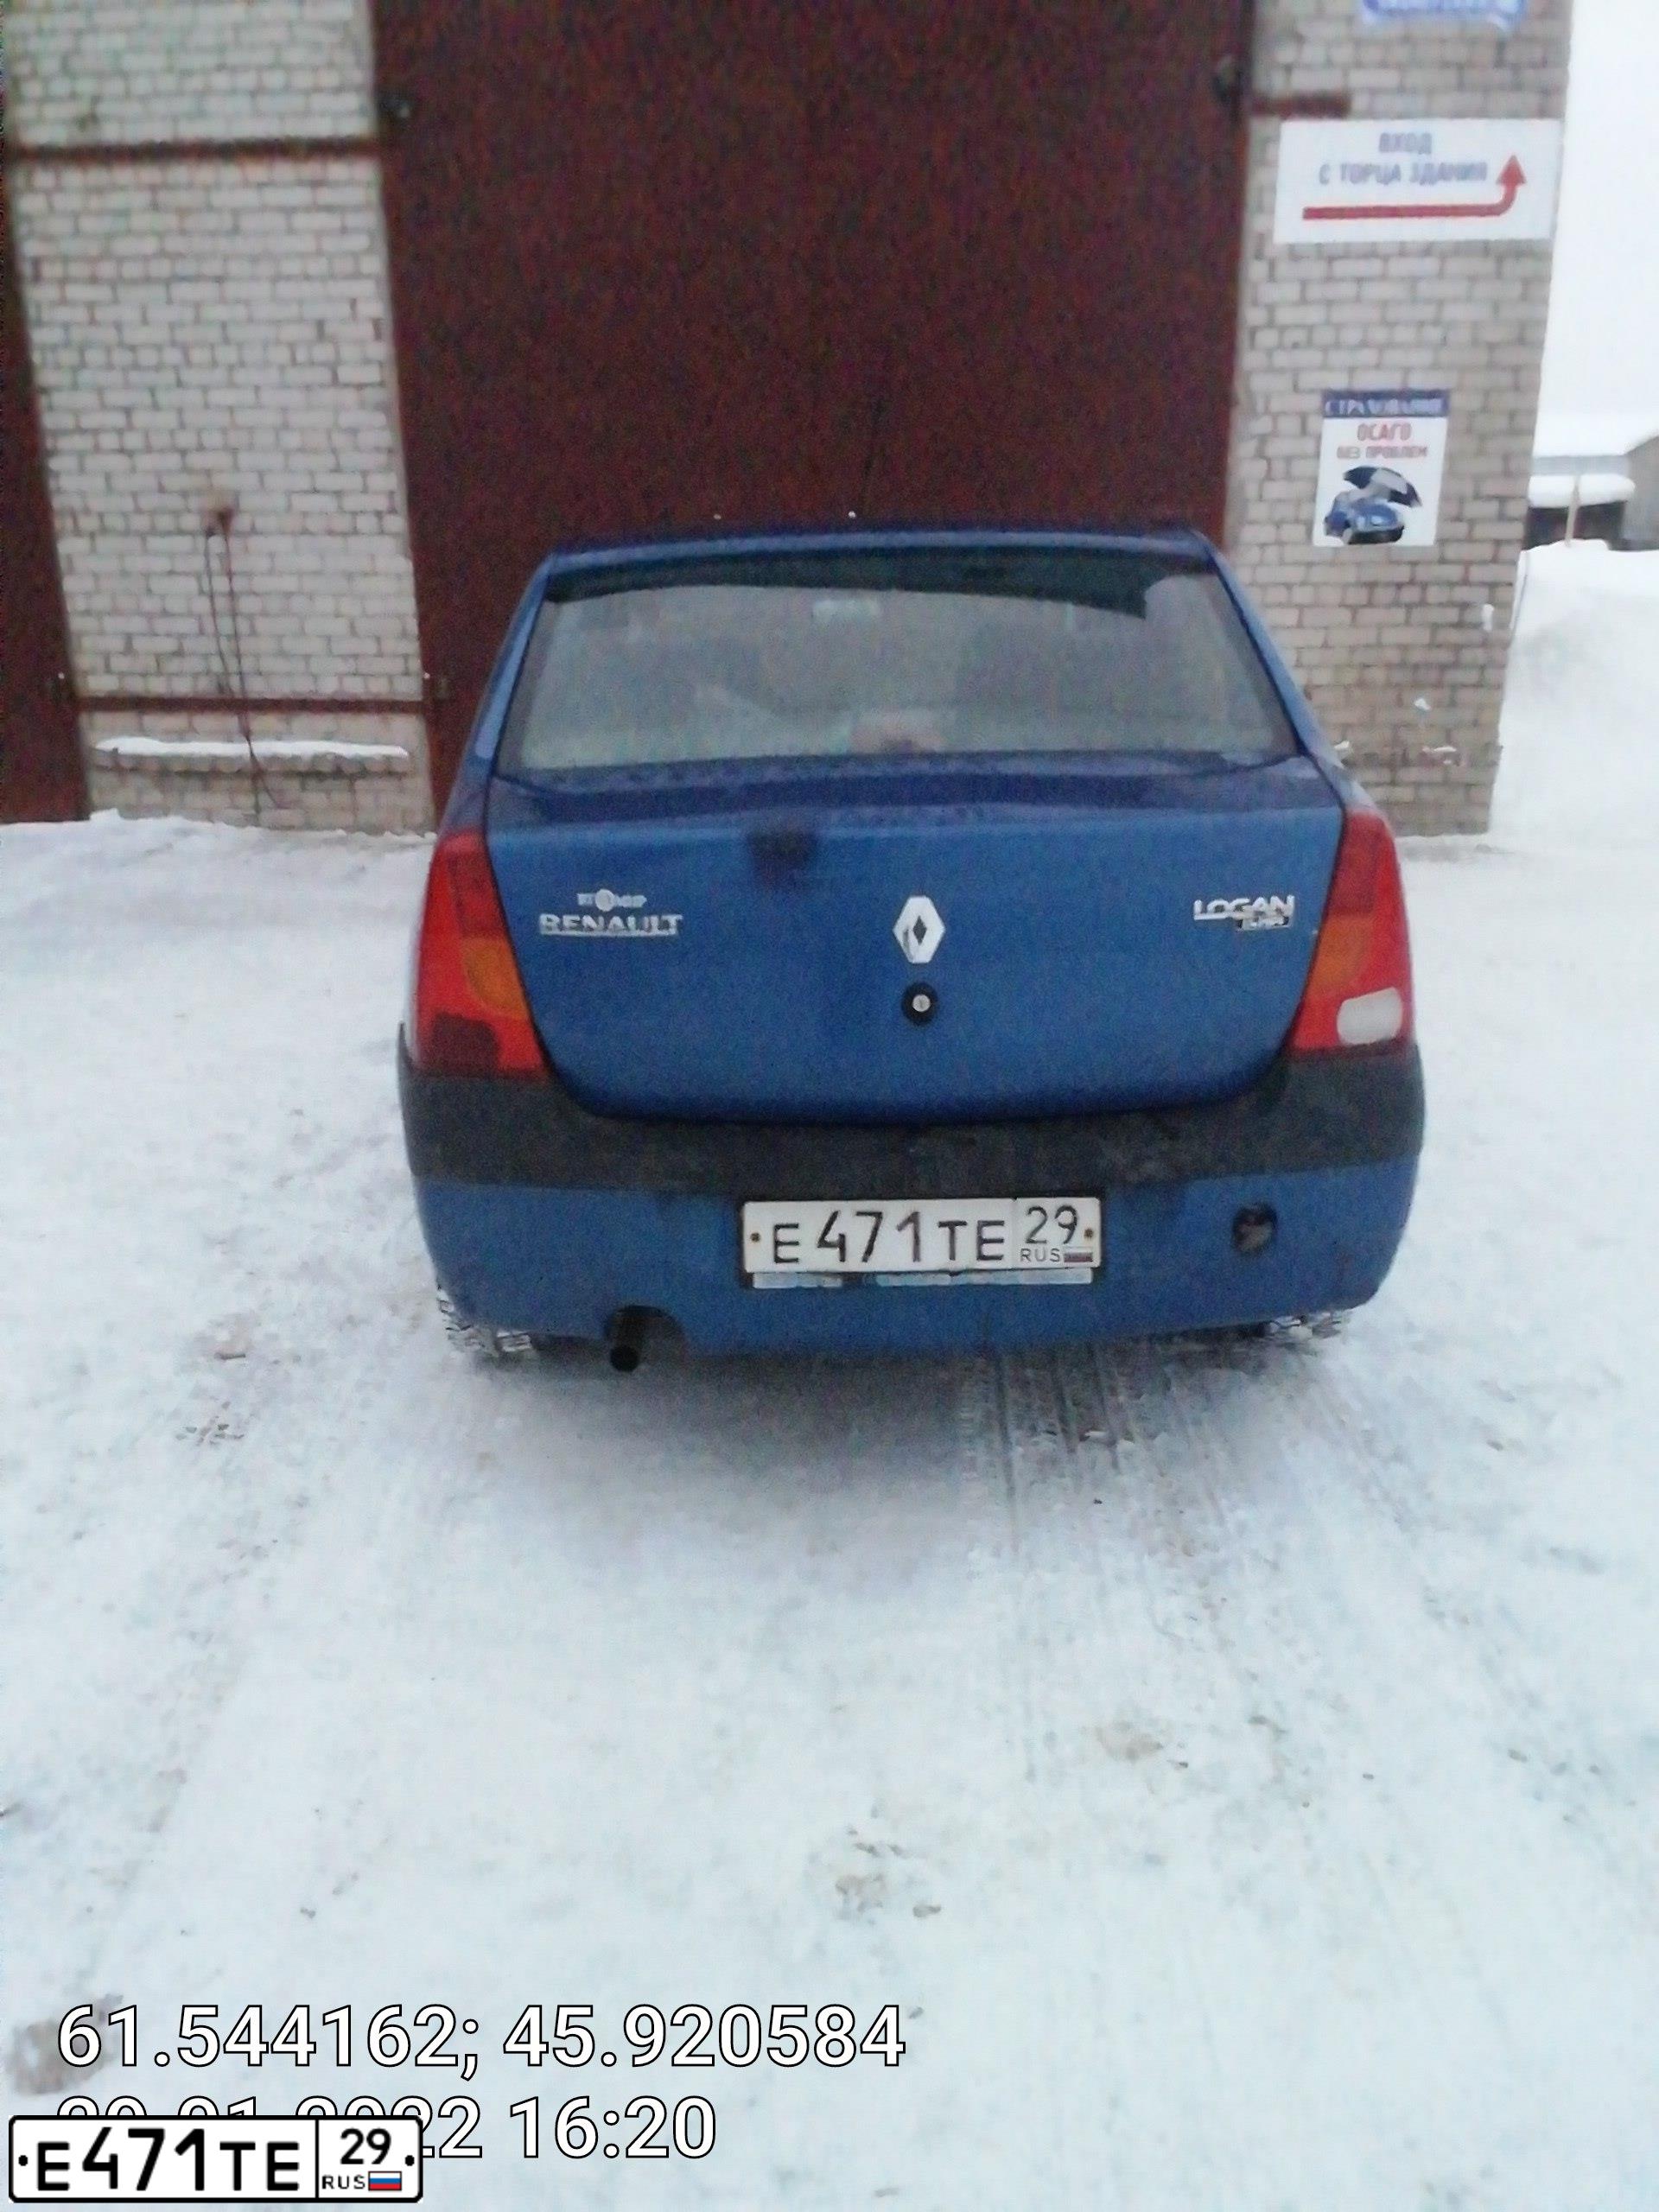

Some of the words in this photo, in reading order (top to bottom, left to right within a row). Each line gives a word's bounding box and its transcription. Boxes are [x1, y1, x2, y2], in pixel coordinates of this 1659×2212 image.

[1193, 894, 1295, 921] LOGAN
[539, 913, 683, 936] RENAULT
[1025, 1205, 1080, 1245] 29
[1020, 1247, 1061, 1263] RUS
